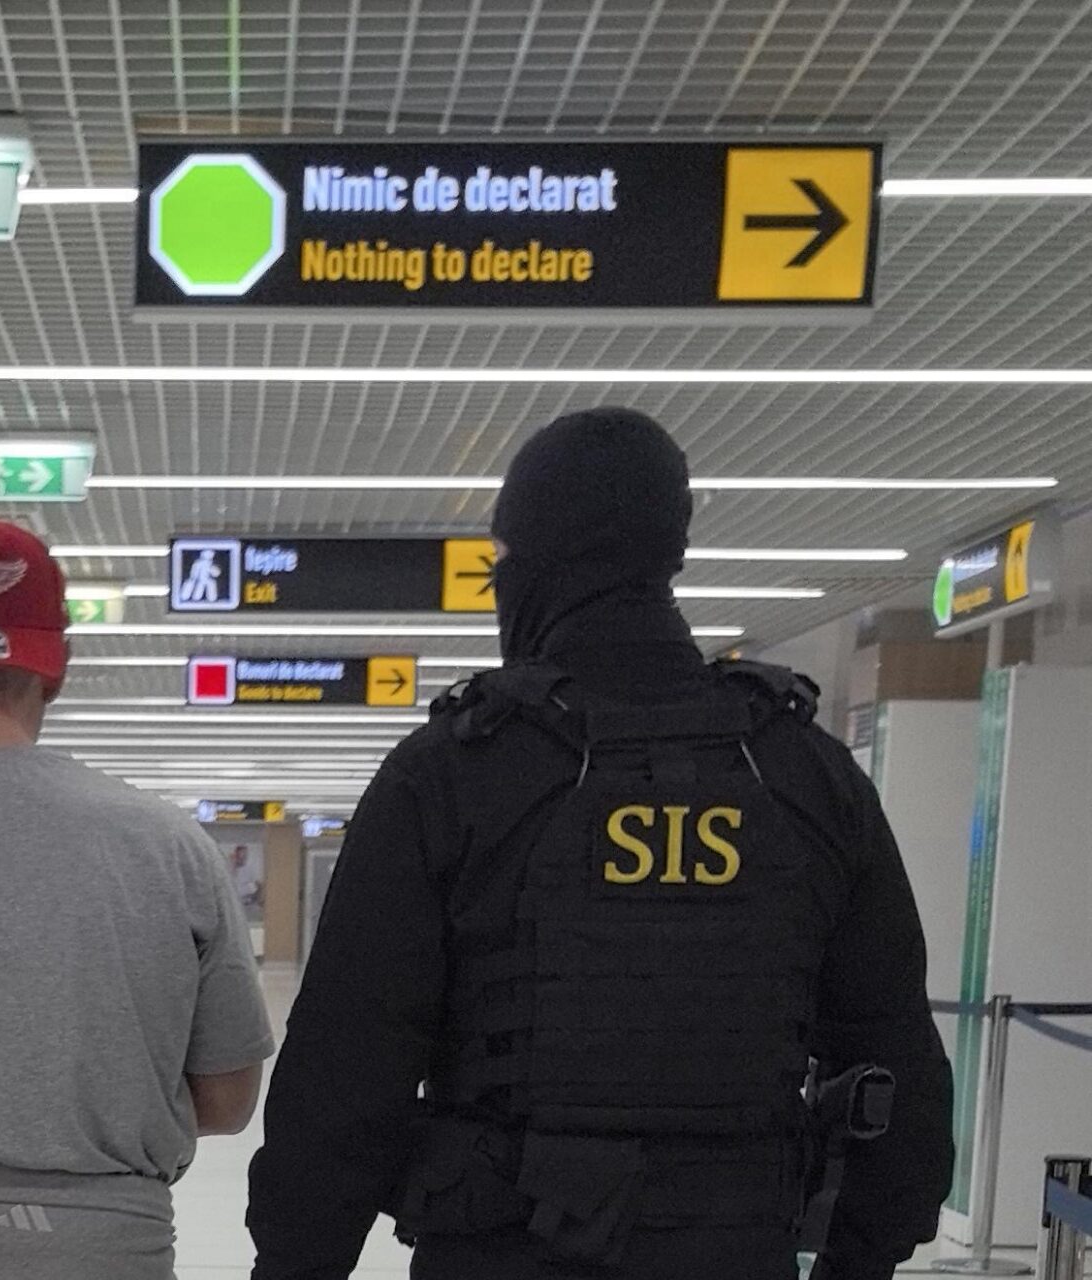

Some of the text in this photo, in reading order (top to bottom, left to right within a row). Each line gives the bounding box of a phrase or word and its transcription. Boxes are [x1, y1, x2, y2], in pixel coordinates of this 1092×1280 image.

[303, 166, 618, 212] Nimic de declarat
[301, 239, 593, 290] Nothing to declare
[244, 581, 277, 604] Exit
[604, 804, 742, 885] SIS
